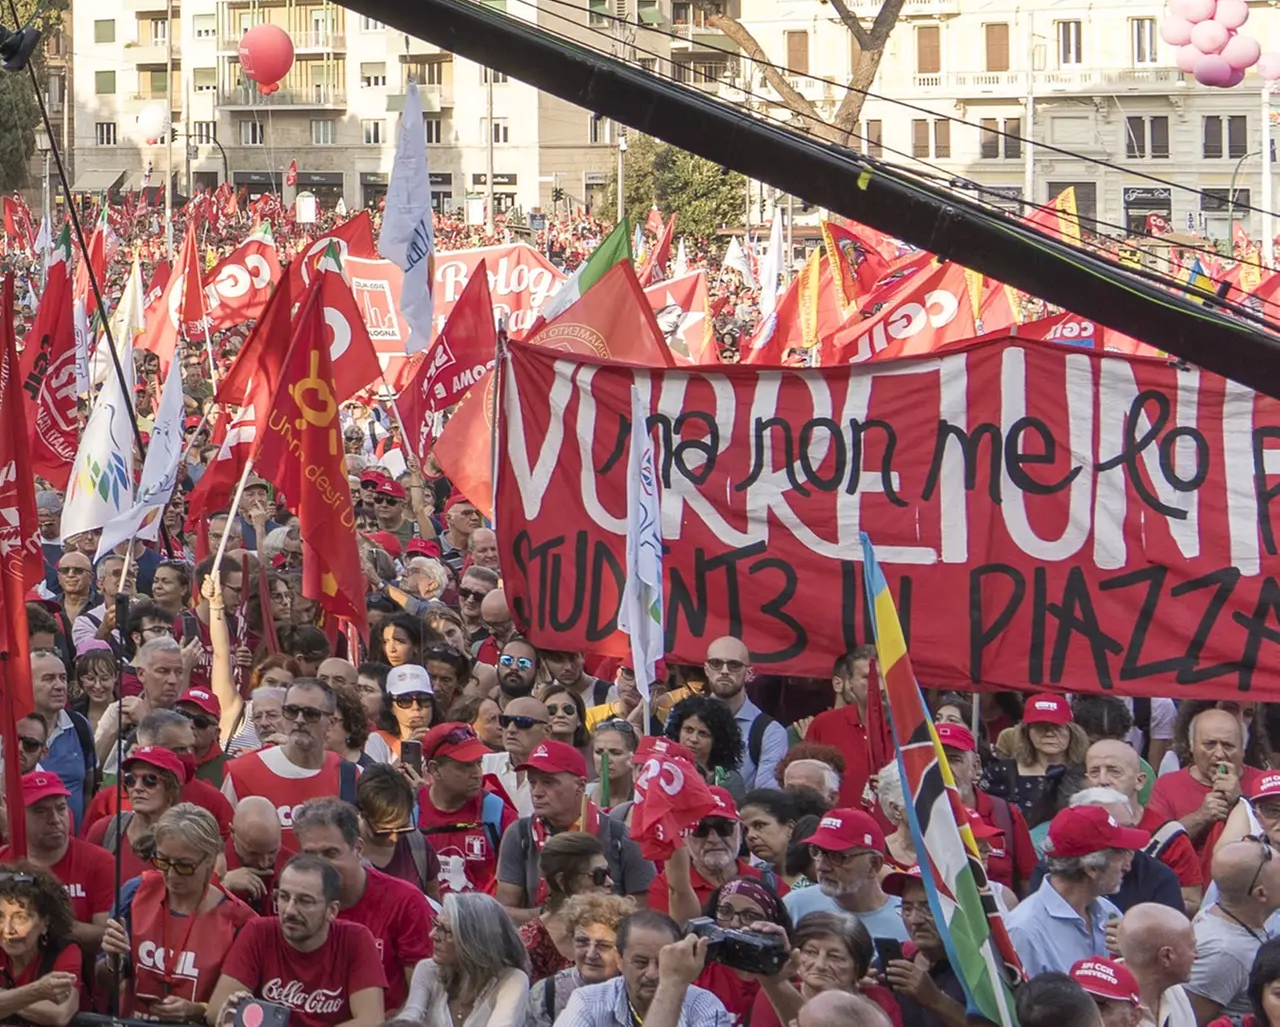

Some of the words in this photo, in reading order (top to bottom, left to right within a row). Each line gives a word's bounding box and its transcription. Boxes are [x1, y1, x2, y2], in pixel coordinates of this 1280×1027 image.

[735, 415, 907, 509] non
[921, 414, 1083, 503] me
[1095, 389, 1209, 519] lo
[1075, 969, 1118, 985] BENEVENTO
[1095, 963, 1115, 976] CGIL
